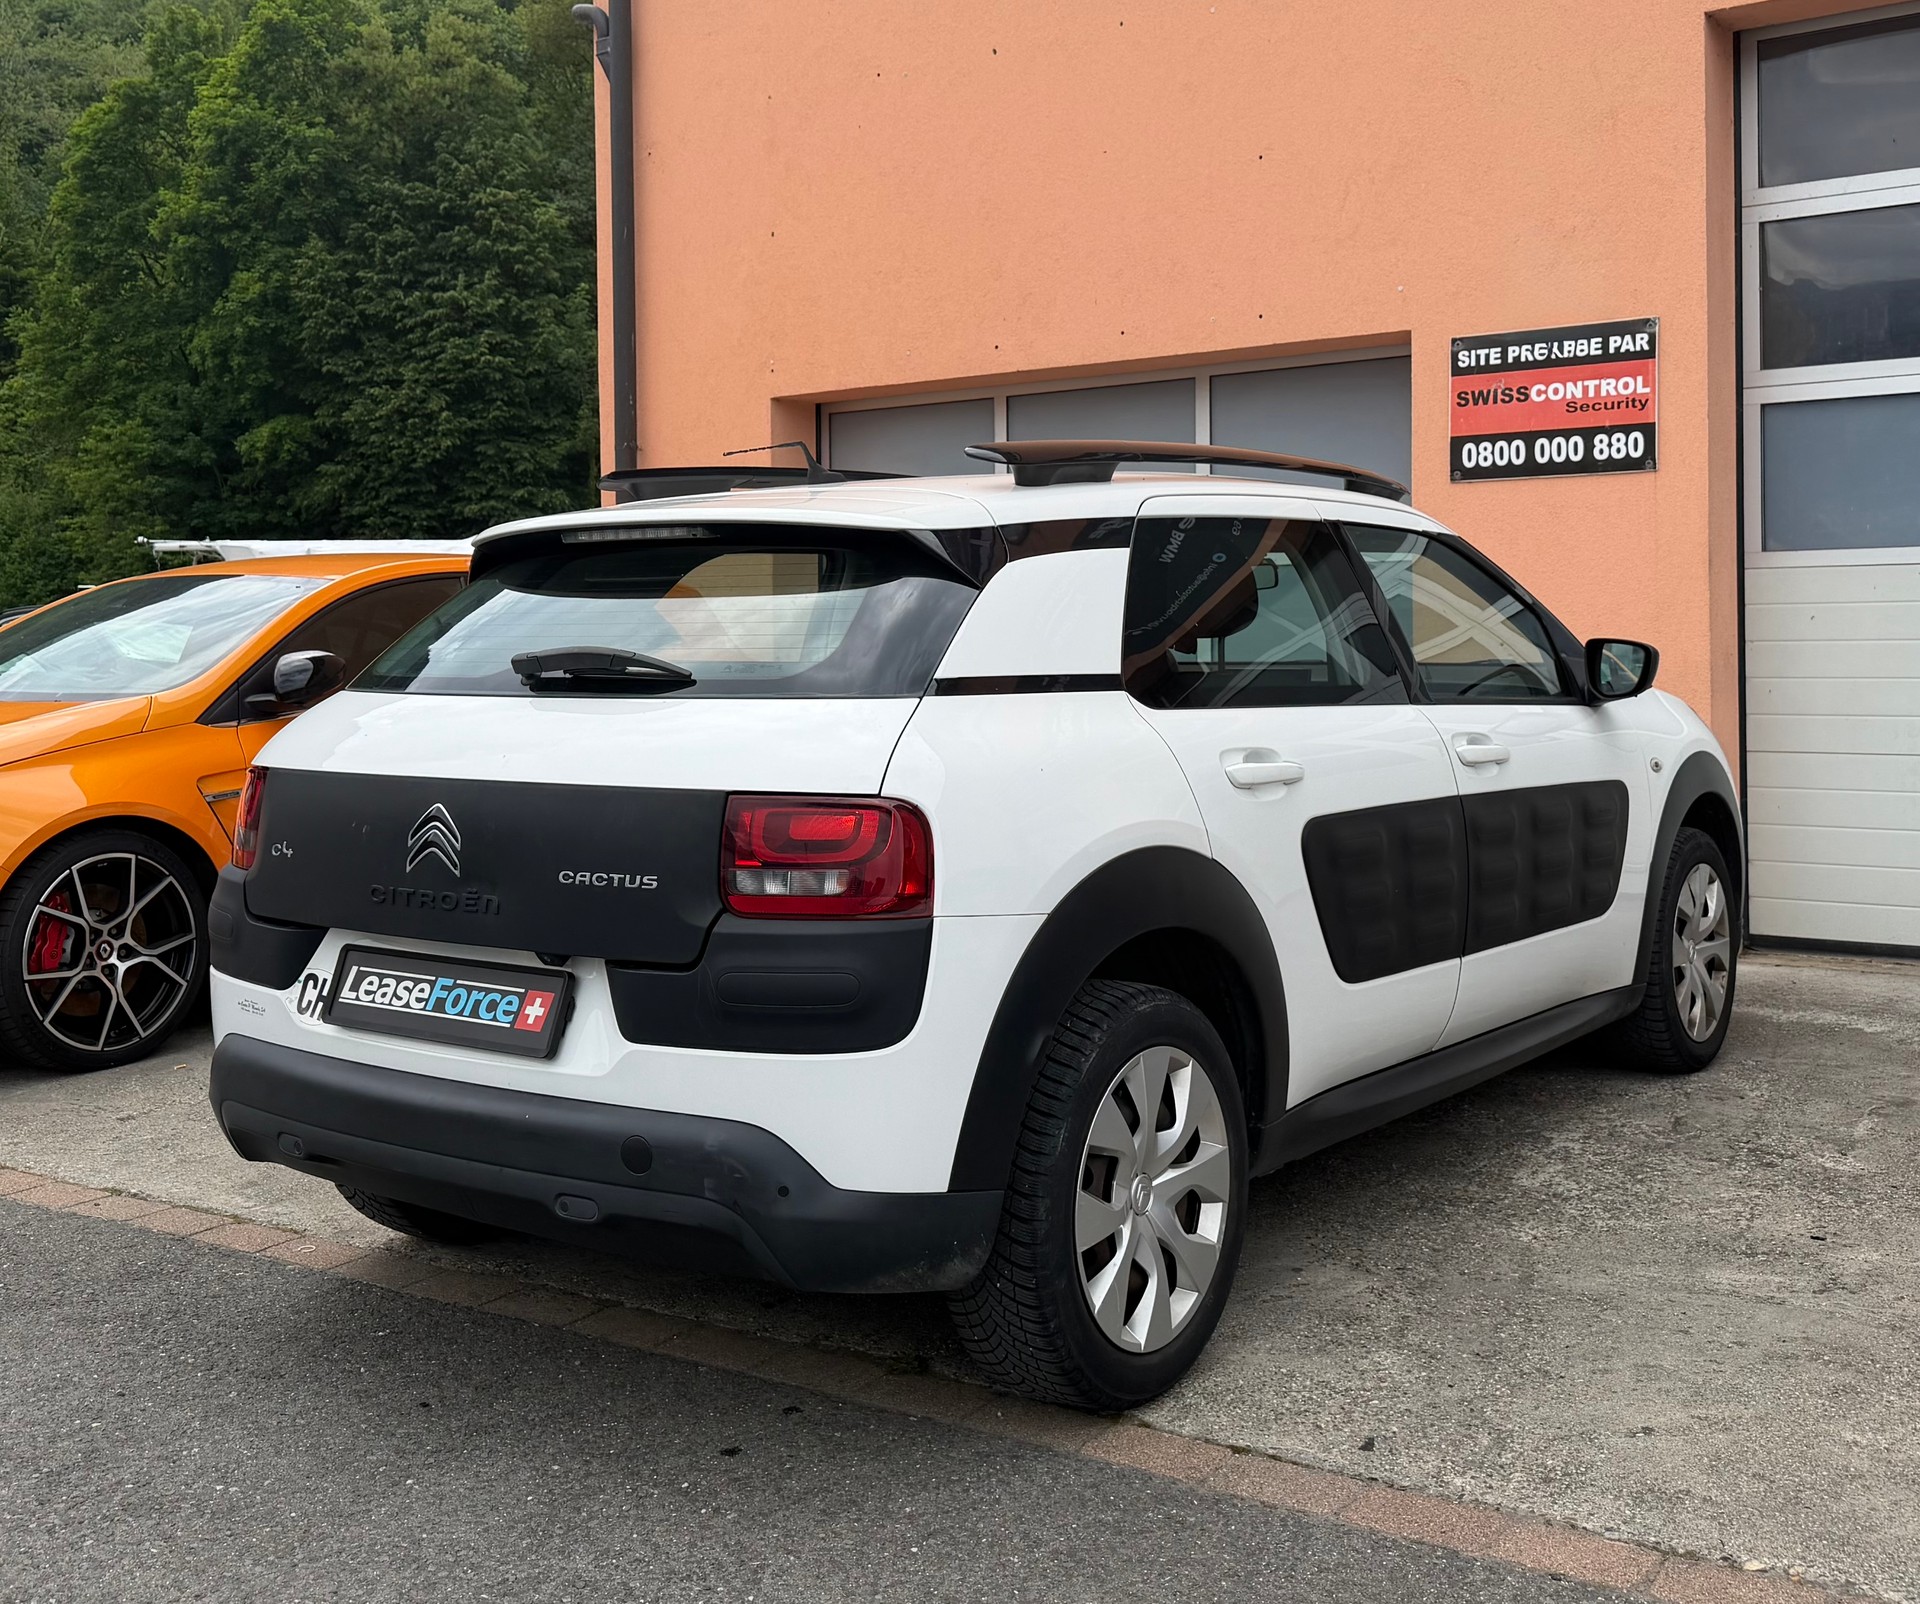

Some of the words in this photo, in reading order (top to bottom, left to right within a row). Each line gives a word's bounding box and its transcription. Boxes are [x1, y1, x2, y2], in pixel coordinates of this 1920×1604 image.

[1457, 347, 1502, 369] SITE
[1608, 333, 1650, 354] PAR
[1565, 397, 1650, 414] Security
[1461, 438, 1526, 469] 0800
[1534, 435, 1585, 464] 000
[1592, 431, 1645, 461] 880
[271, 840, 294, 859] C4
[558, 870, 659, 889] CACTUS
[369, 884, 501, 916] CITROËN
[341, 965, 521, 1024] LeaseForce
